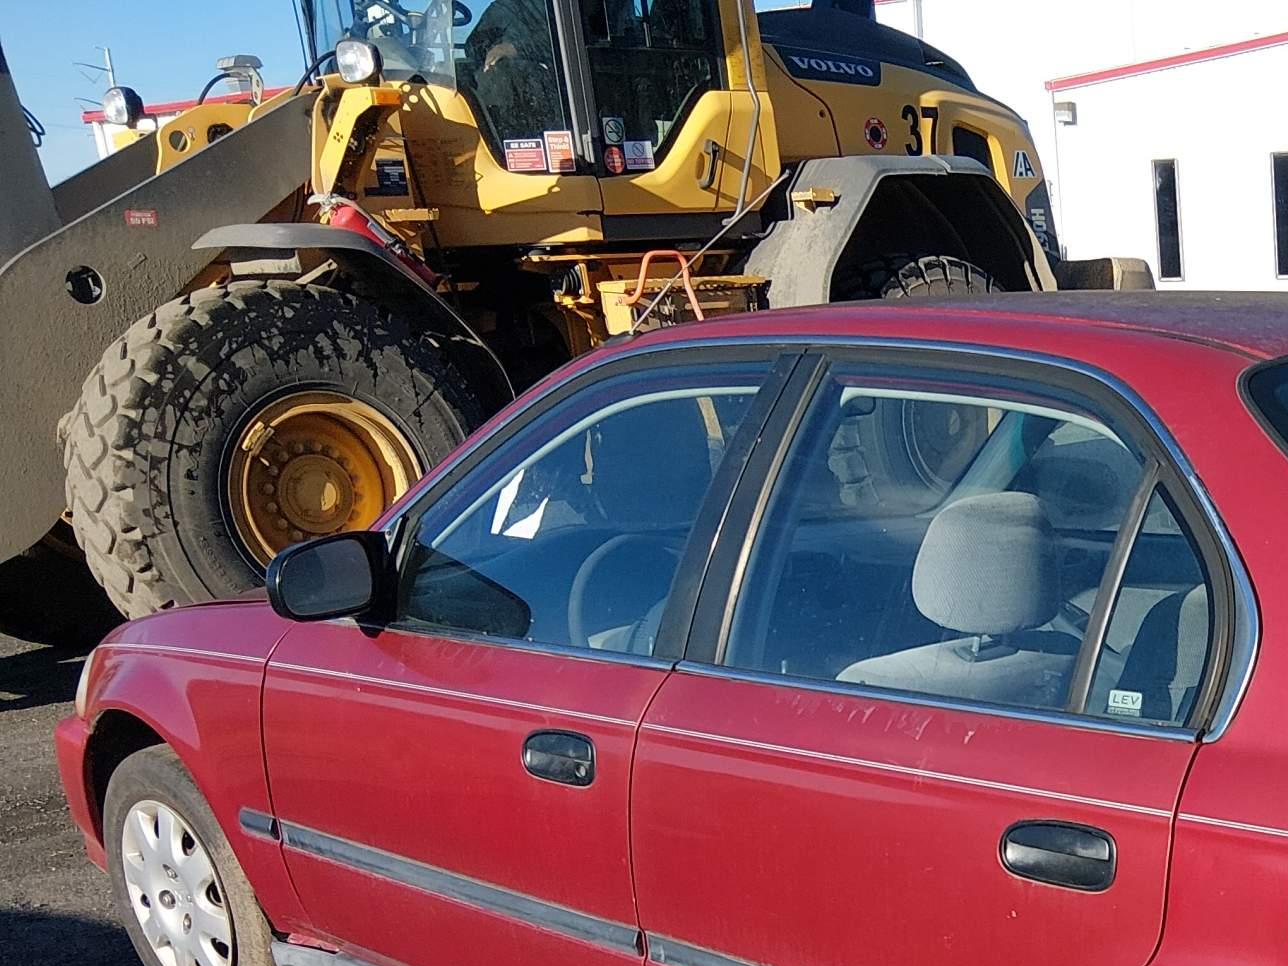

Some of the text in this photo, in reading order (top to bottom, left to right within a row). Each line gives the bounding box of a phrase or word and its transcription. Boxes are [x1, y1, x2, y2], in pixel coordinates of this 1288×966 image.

[788, 56, 873, 77] VOLVO
[902, 105, 938, 156] 37
[1112, 694, 1140, 705] LEV
